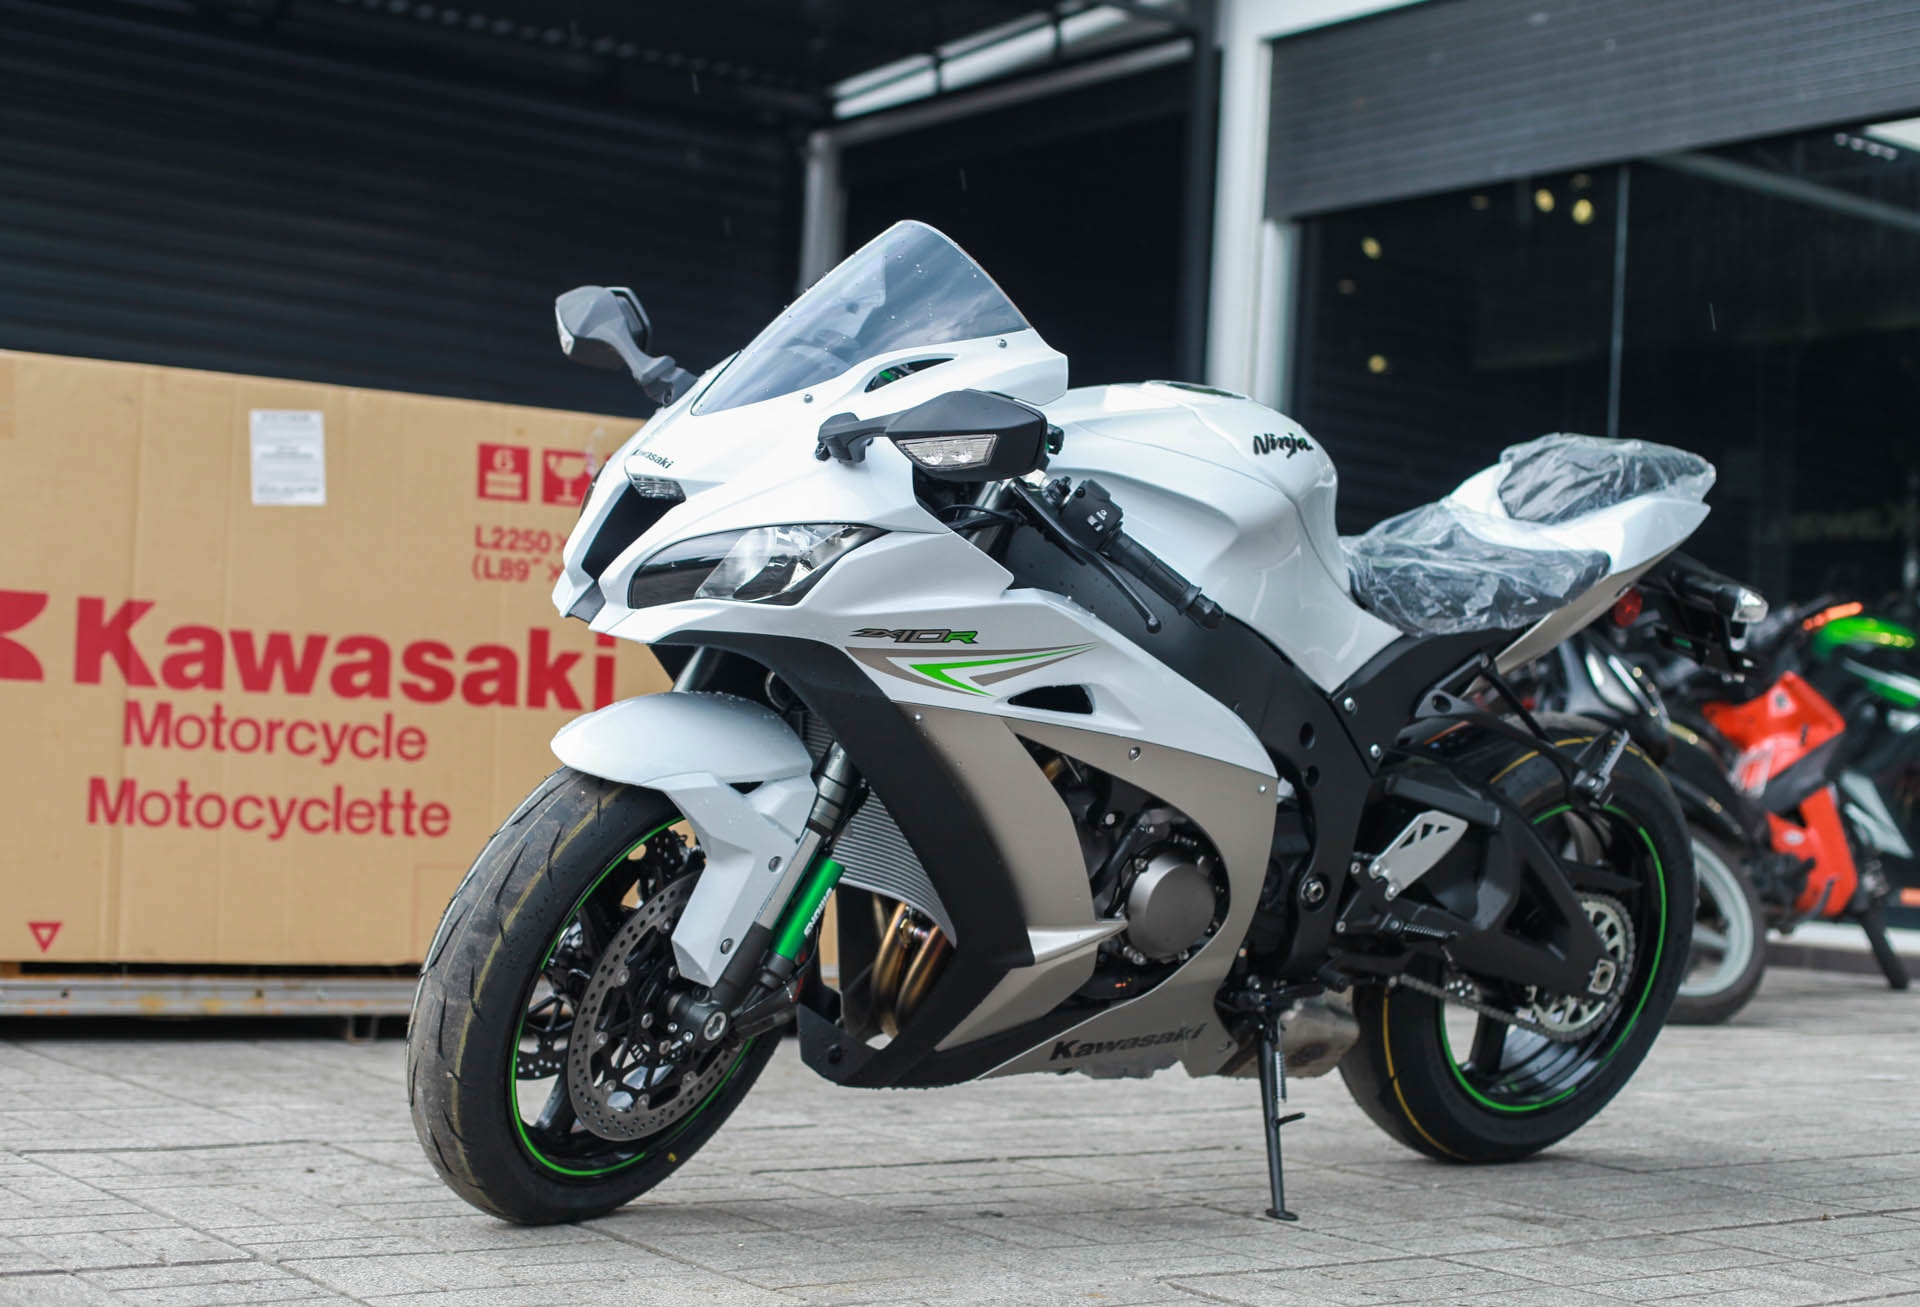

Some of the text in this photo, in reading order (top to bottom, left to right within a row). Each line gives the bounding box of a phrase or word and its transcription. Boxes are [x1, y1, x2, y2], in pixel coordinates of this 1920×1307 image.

[492, 448, 516, 473] 6
[632, 448, 674, 469] asaki
[1252, 432, 1315, 459] Ninja
[474, 524, 552, 555] L2250
[73, 595, 617, 712] Kawasaki
[123, 699, 429, 766] Motorcycle
[87, 776, 453, 841] Motocyclette
[1050, 1022, 1208, 1061] Kawasaki
